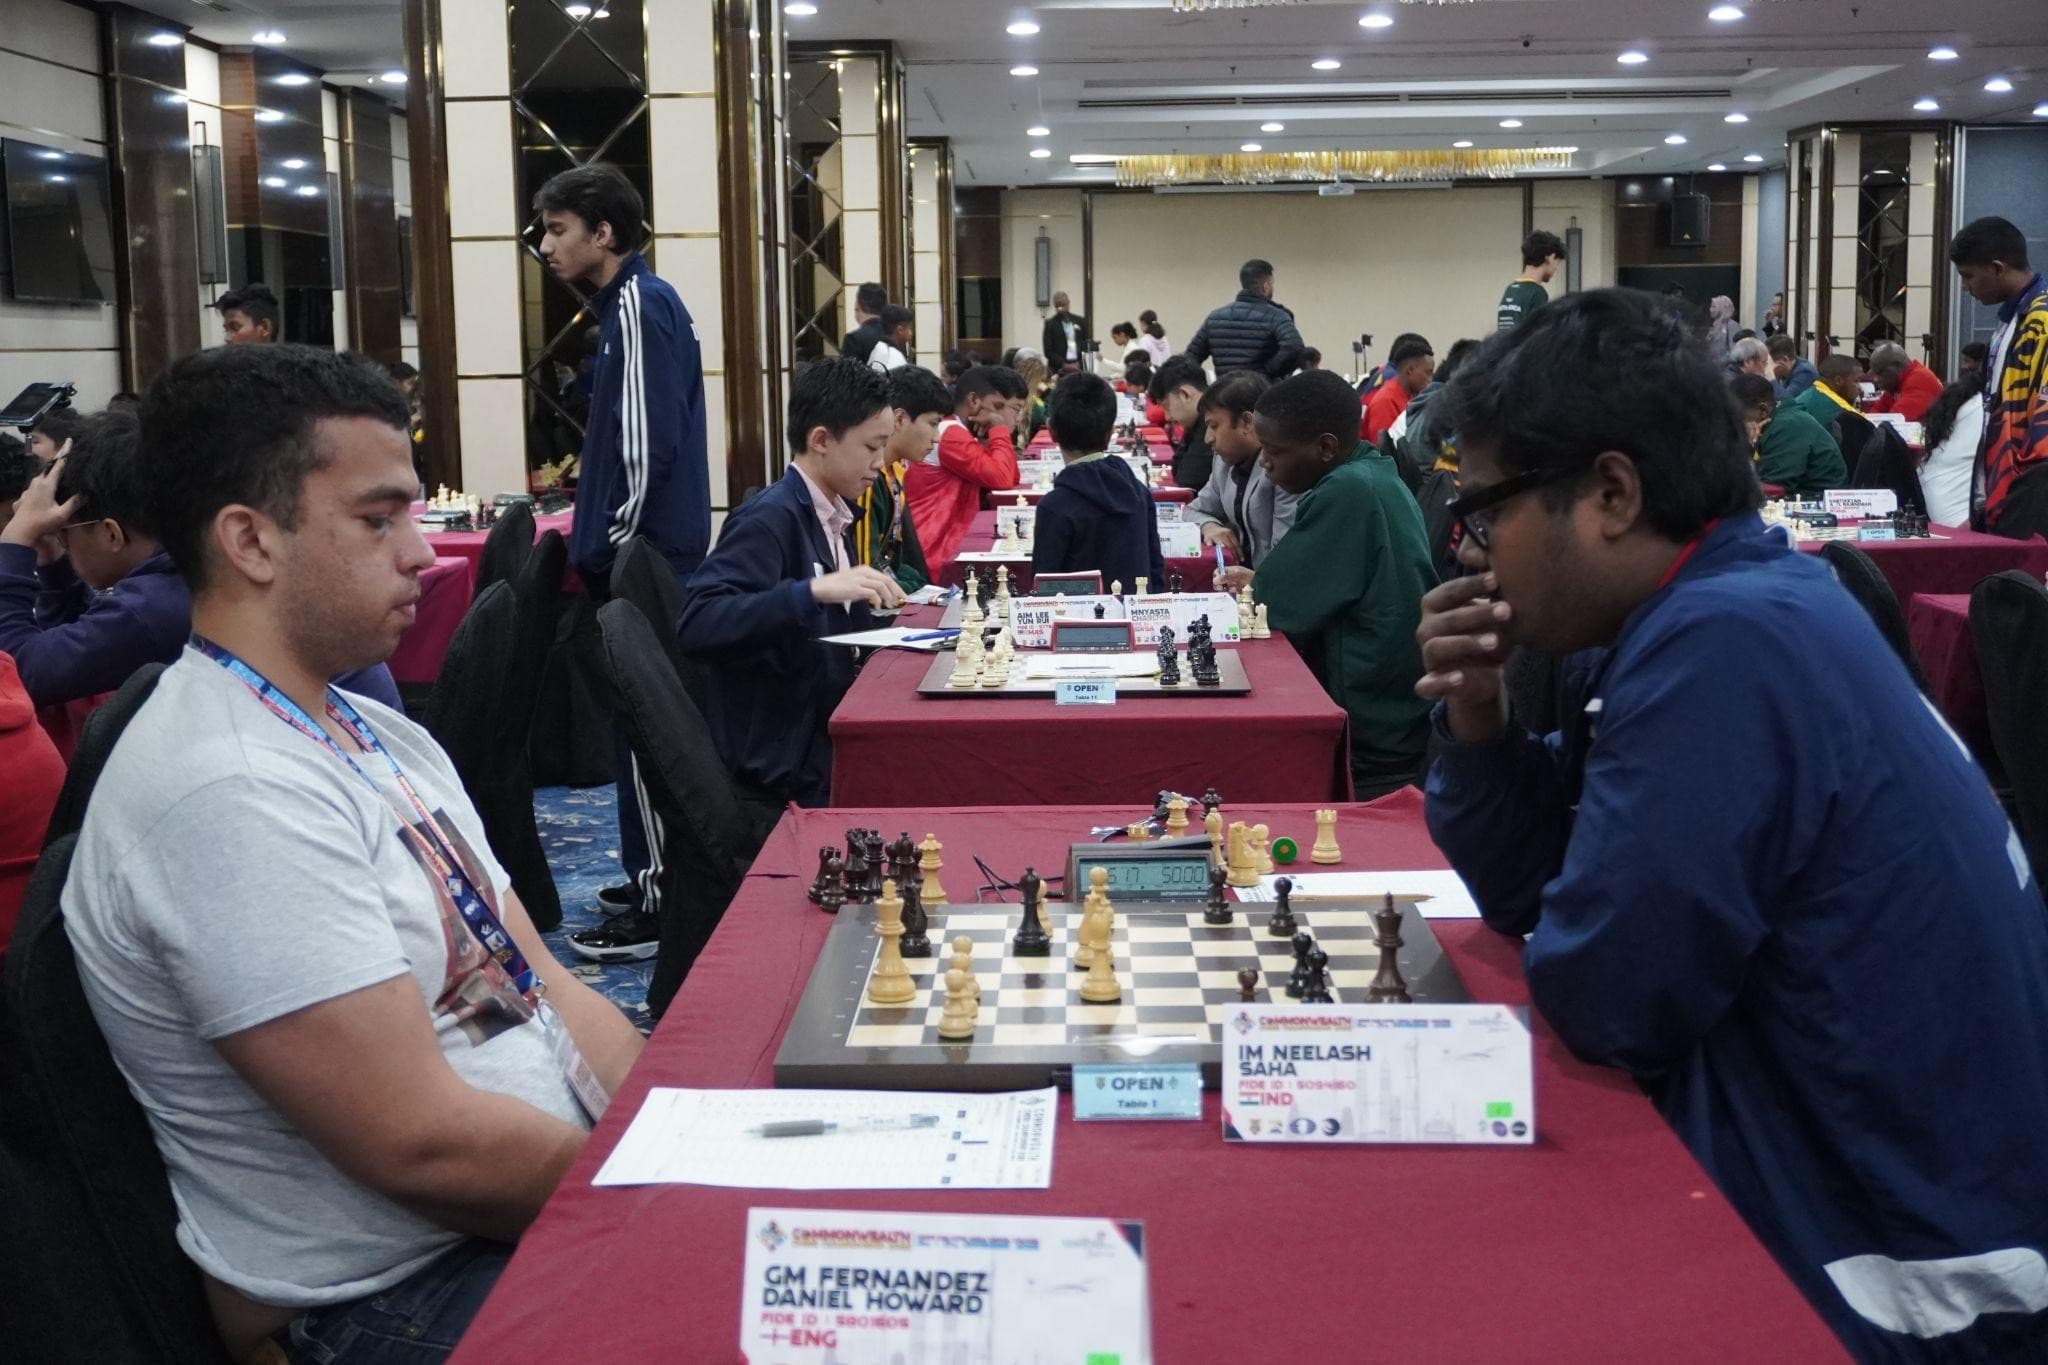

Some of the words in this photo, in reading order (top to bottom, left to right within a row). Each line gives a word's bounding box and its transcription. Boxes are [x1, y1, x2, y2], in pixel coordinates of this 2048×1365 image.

[1130, 608, 1170, 616] MNYASTA
[1073, 684, 1099, 692] OPEN
[1238, 1045, 1262, 1060] IM
[1272, 1045, 1371, 1061] NEELASH
[1239, 1062, 1297, 1077] SAHA
[1111, 1077, 1163, 1091] OPEN
[1117, 1100, 1148, 1108] Table
[1260, 1092, 1294, 1106] IND
[763, 1265, 806, 1287] GM
[818, 1267, 989, 1293] FERNANDEZ
[762, 1288, 853, 1309] DANIEL
[866, 1292, 983, 1314] HOWARD
[802, 1314, 818, 1327] ID
[789, 1328, 837, 1349] ENG
